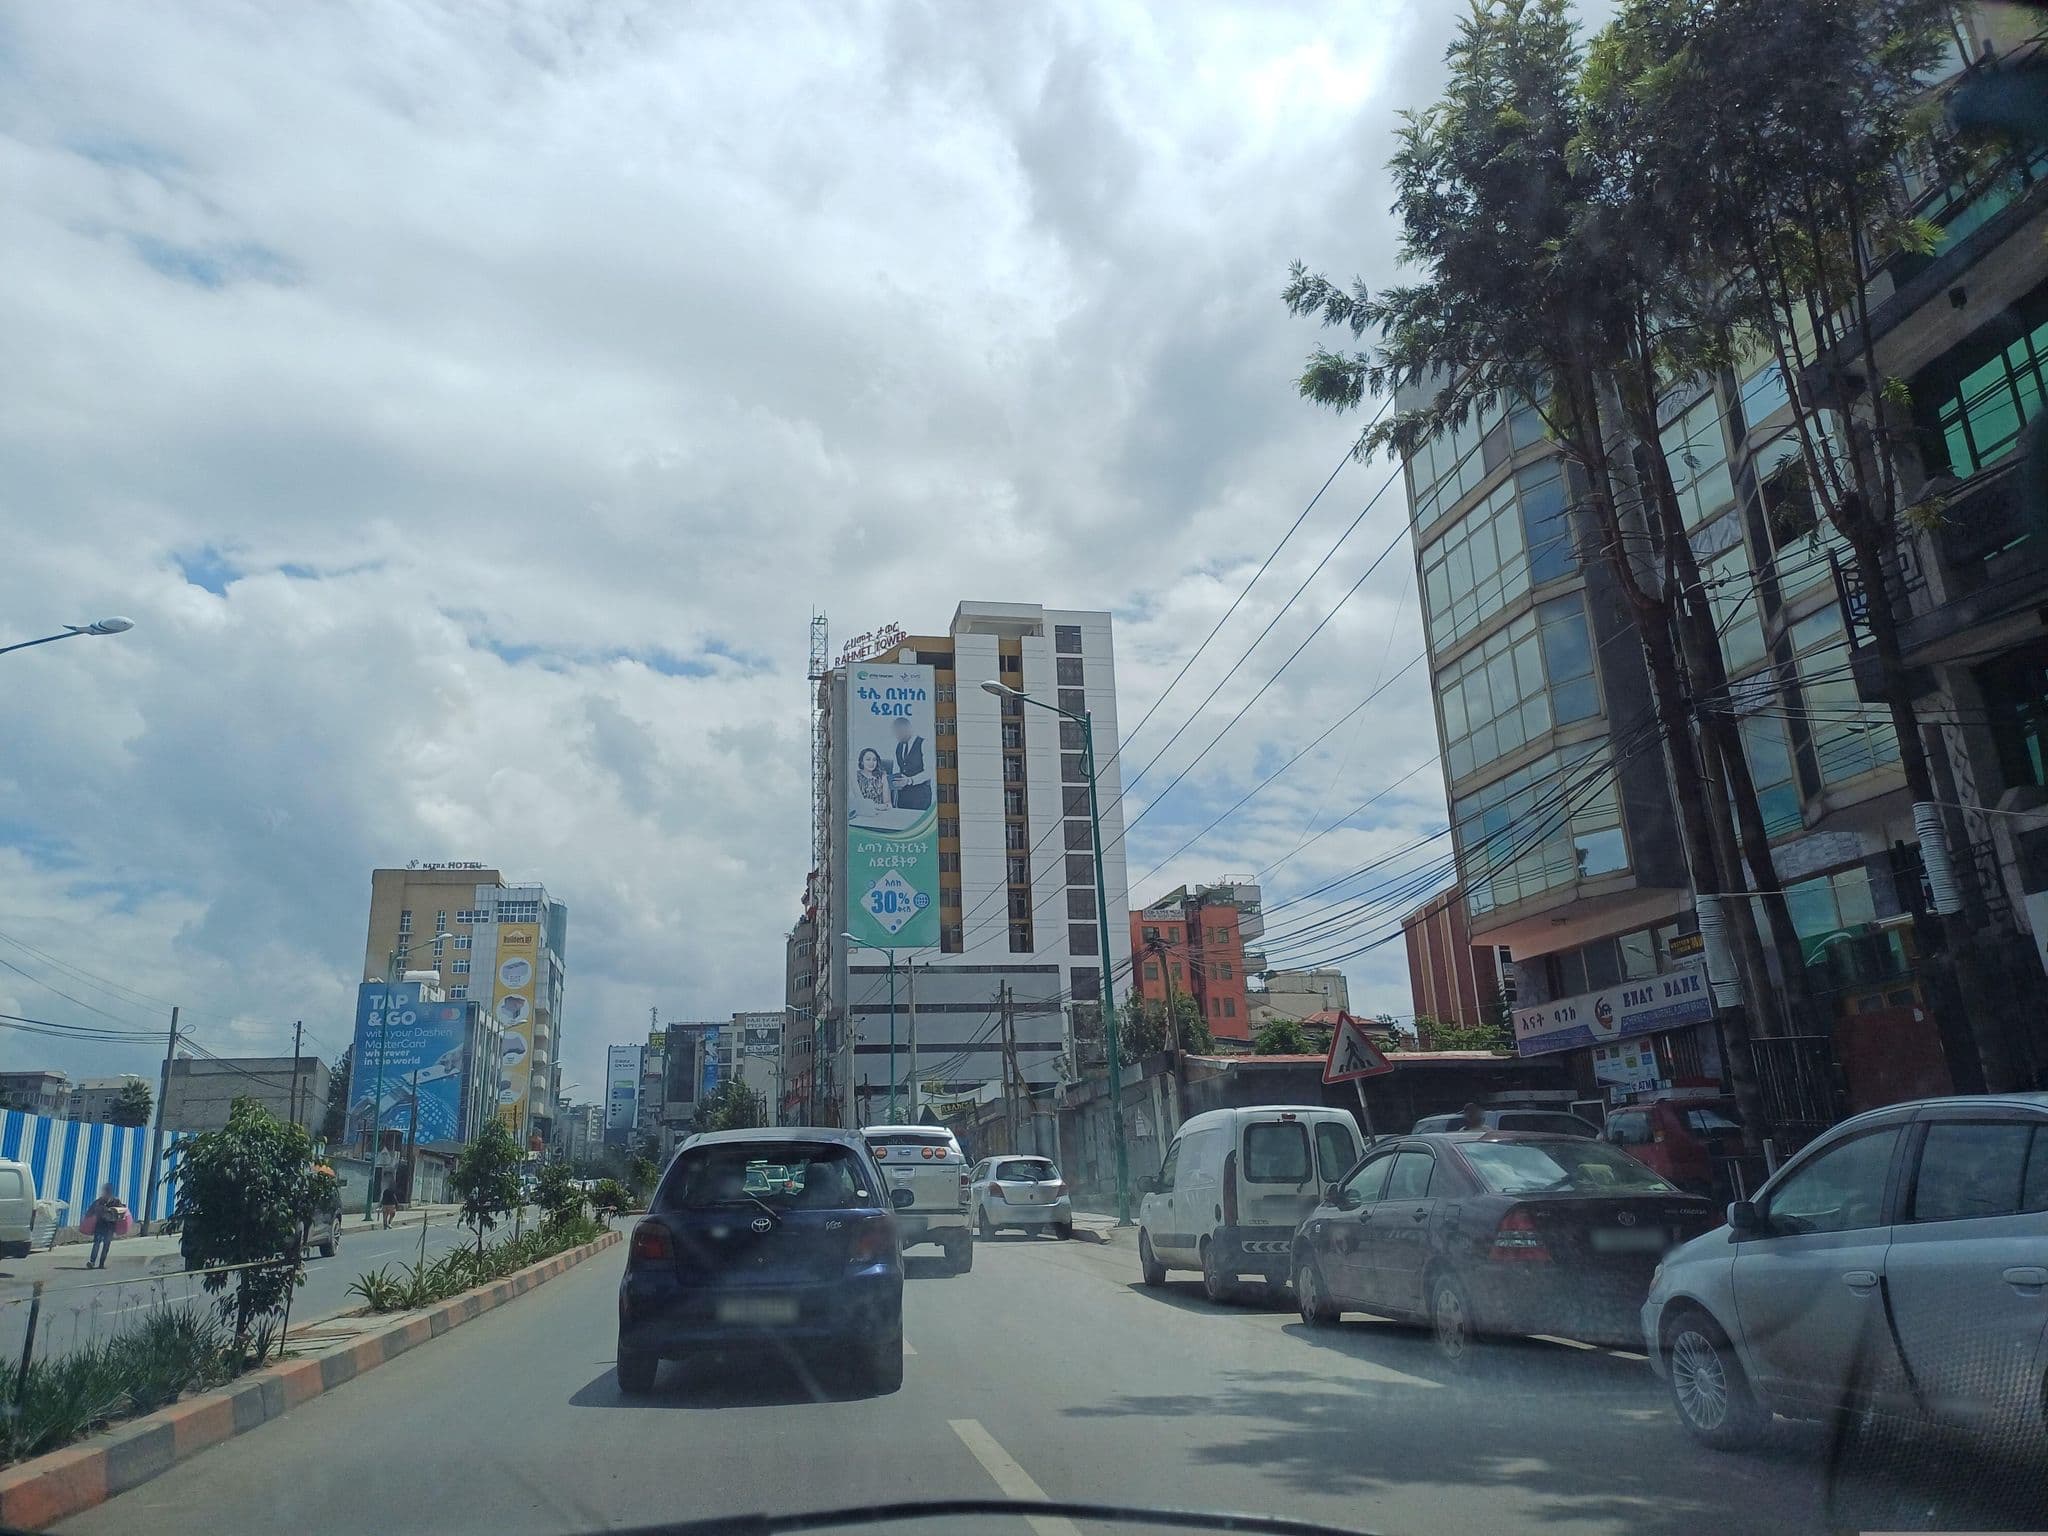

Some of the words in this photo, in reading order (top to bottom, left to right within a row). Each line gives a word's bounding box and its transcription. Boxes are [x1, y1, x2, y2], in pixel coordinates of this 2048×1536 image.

[834, 644, 872, 667] RAHMET
[875, 631, 907, 652] TOWER
[871, 890, 910, 914] 30%
[1623, 986, 1654, 1008] ENAT
[1663, 975, 1701, 998] BANK
[370, 994, 408, 1010] TAP
[368, 1011, 382, 1026] &
[386, 1011, 417, 1026] GO
[391, 1030, 412, 1040] your
[393, 1056, 420, 1065] world
